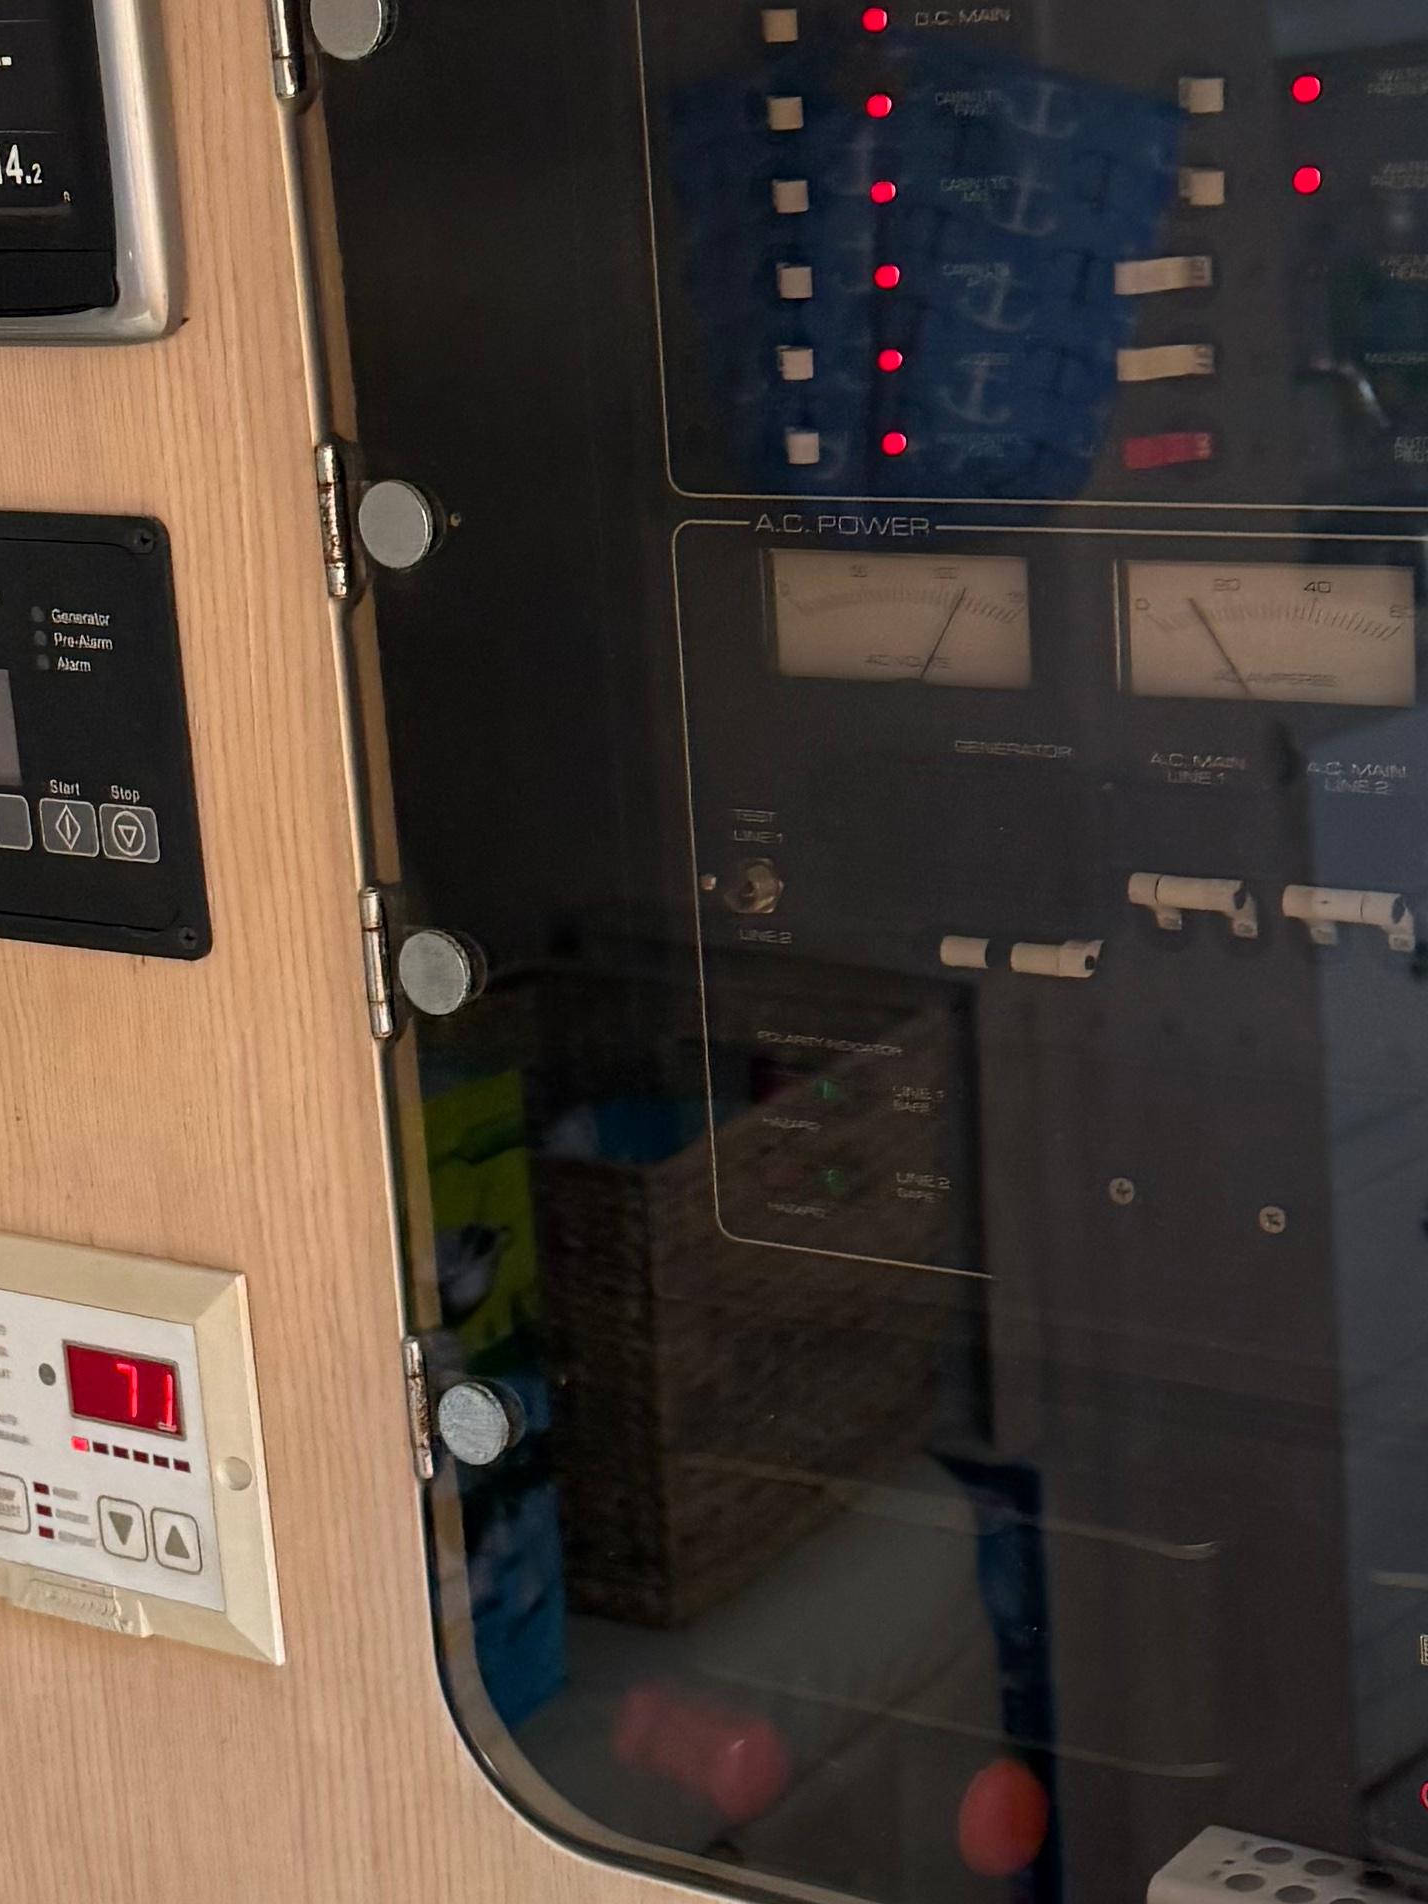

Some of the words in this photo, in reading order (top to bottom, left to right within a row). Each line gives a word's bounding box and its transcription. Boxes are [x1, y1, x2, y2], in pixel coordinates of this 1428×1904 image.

[959, 7, 1012, 25] MAIN
[753, 513, 810, 534] A.C.
[817, 515, 932, 538] POWER
[1303, 581, 1333, 595] 40
[51, 608, 111, 628] Generator
[53, 633, 113, 652] Pre-Alarm
[57, 656, 91, 673] Alarm
[1350, 763, 1406, 779] MAIN
[50, 780, 81, 797] Start
[110, 786, 140, 804] Stop
[1375, 781, 1390, 796] 2
